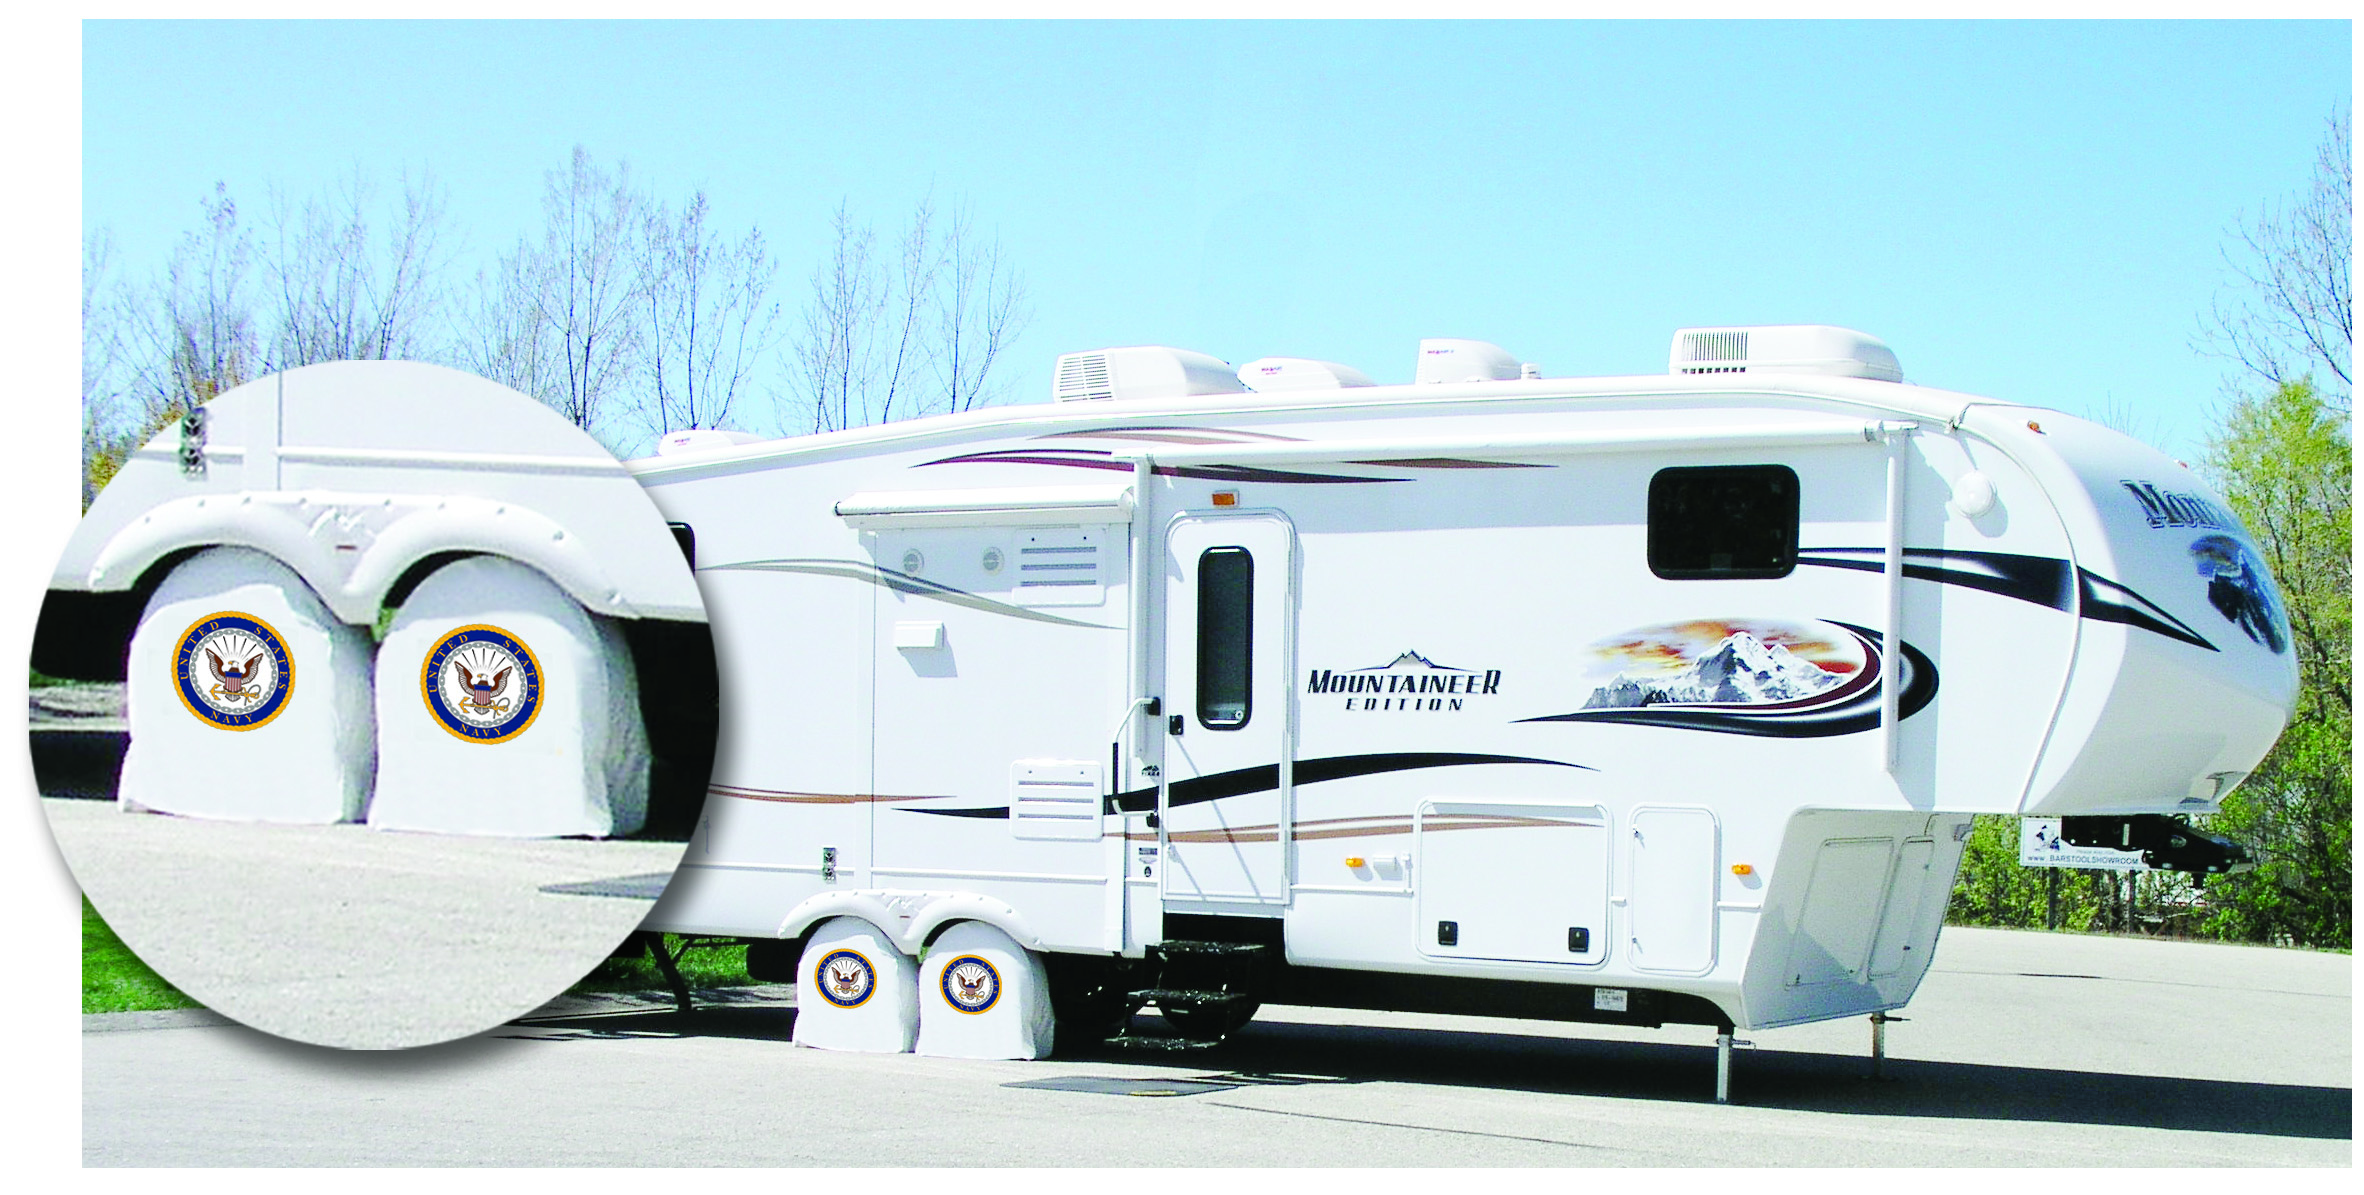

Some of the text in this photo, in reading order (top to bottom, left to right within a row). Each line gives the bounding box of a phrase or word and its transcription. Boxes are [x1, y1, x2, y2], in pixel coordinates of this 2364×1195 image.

[179, 621, 288, 690] UNITED STATES
[428, 634, 537, 703] UNITED STATES
[1307, 669, 1502, 694] MOUNTAINEER
[1346, 697, 1463, 711] EDITION
[210, 710, 253, 724] NAVY
[459, 723, 502, 737] NAVY
